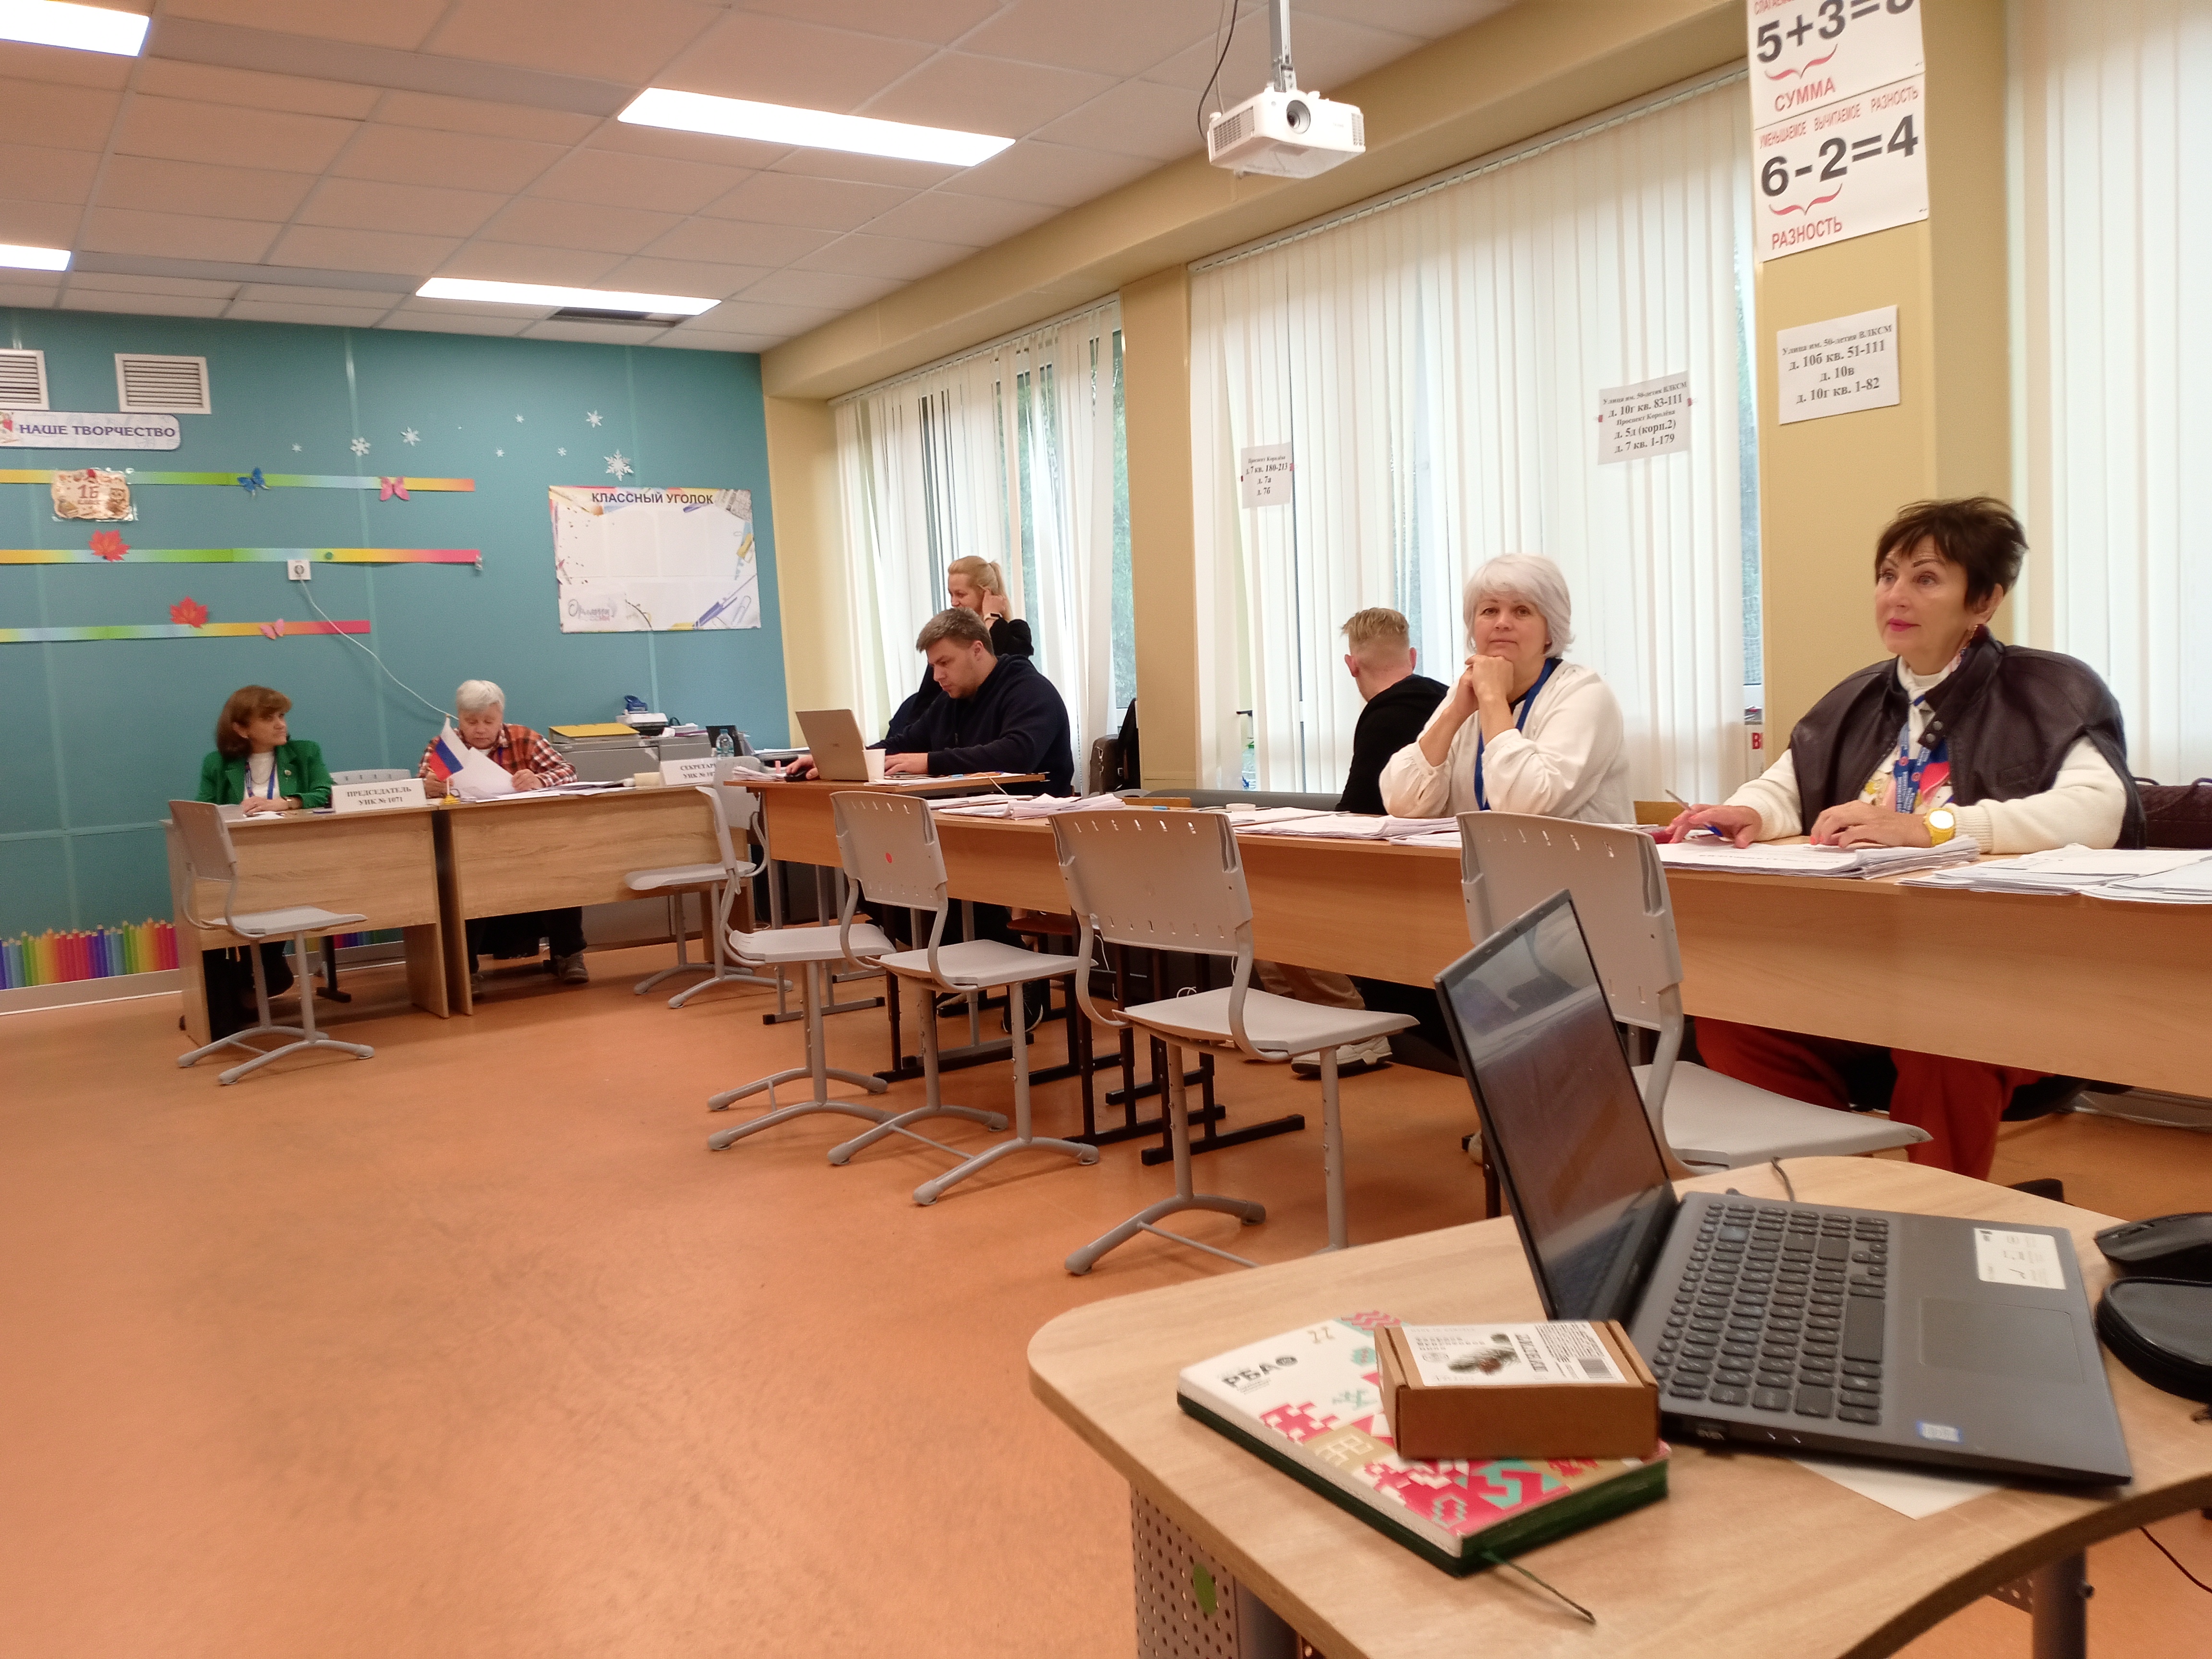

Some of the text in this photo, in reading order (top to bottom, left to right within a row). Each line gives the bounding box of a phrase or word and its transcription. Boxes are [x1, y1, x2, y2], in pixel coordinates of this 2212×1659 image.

[1774, 77, 1836, 112] СУММА
[1759, 85, 1919, 149] УМЕНЬШАЕМОЕ ВЫЧИТАЕМОЕ РАЗНОСТЬ
[1771, 216, 1843, 250] РАЗНОСТЬ
[1859, 324, 1893, 338] ВЛКСМ
[1788, 339, 1885, 371] д. 10б кв. 51-111
[1819, 366, 1855, 383] д. 10в
[1796, 377, 1880, 404] д. 10г кв. 1-82
[1608, 393, 1682, 418] д. 10г кв. 83-111
[1616, 416, 1645, 426] Проспект
[19, 424, 176, 437] НАШЕ ТВОРЧЕСТВО
[1614, 433, 1675, 453] д. 7 кв. 1-179
[1266, 462, 1288, 472] 180-213
[591, 492, 714, 504] КЛАССНЫЙ УГОЛОК
[347, 787, 412, 797] ПРЕДСЕДАТЕЛЬ
